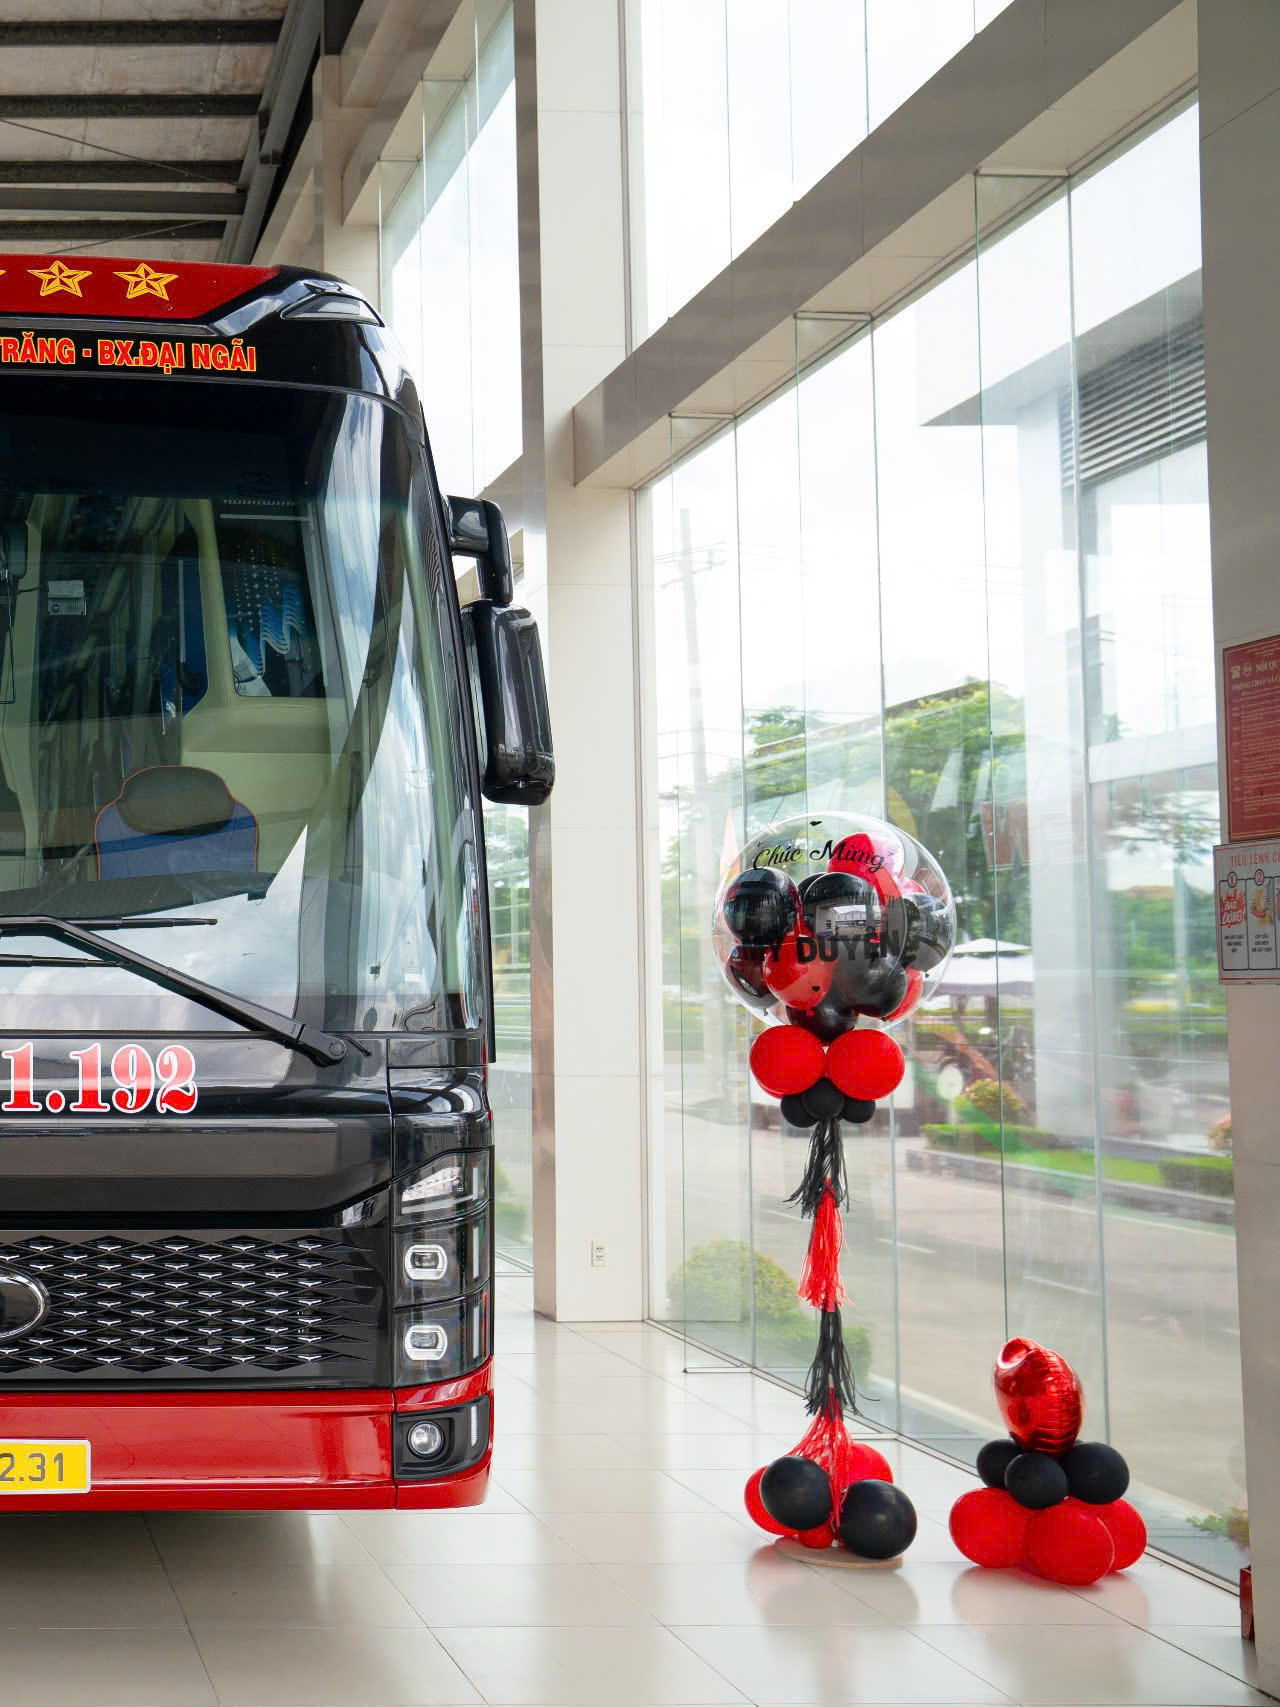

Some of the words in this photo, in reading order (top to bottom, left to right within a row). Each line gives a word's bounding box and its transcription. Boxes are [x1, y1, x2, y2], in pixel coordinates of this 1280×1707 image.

[97, 340, 185, 374] BX.ĐẠI
[192, 339, 257, 371] NGÃI
[752, 845, 803, 870] Chúc
[809, 839, 886, 873] Mừng
